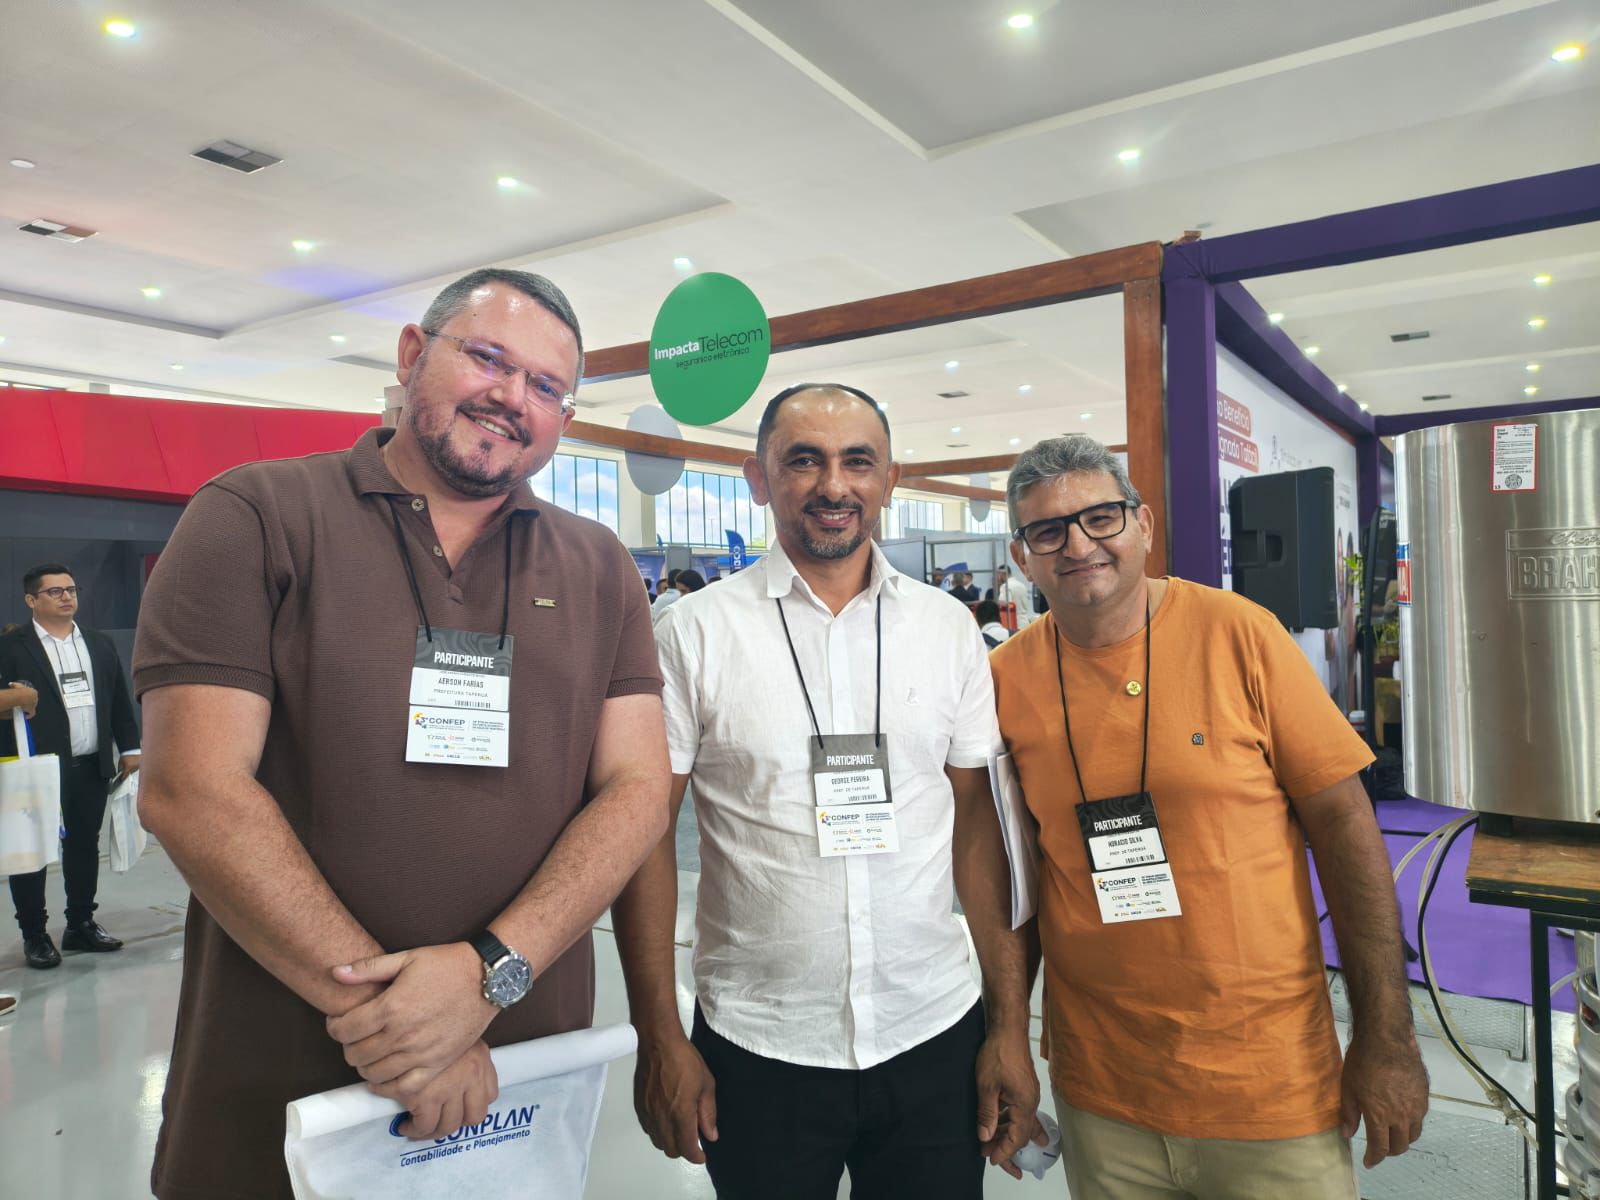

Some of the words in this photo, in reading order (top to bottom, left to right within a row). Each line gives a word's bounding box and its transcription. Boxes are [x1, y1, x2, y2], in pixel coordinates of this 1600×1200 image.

[434, 651, 495, 669] PARTICIPANTE
[429, 717, 466, 726] CONFEP
[826, 754, 875, 767] PARTICIPANTE
[1093, 814, 1143, 832] PARTICIPANTE
[1108, 877, 1136, 886] CONFEP
[400, 1144, 463, 1167] Contabilidade
[465, 1143, 471, 1151] e
[473, 1128, 531, 1150] Planejamento
